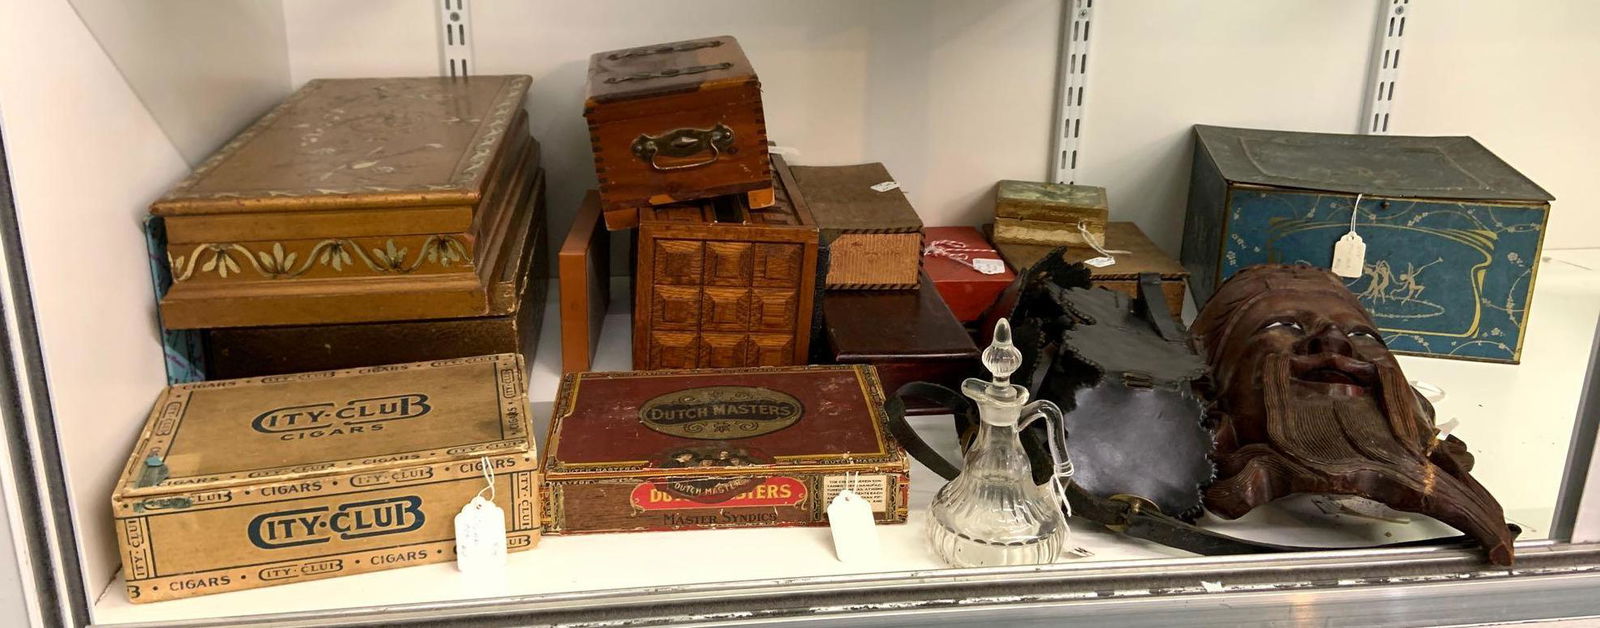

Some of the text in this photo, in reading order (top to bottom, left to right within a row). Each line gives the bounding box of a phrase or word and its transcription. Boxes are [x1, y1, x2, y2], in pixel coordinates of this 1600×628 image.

[183, 380, 236, 390] CIGARS
[358, 364, 408, 375] CIGARS
[651, 404, 791, 420] DUTCH MASTERS
[280, 423, 384, 441] CIGARS
[362, 455, 421, 465] CIGARS
[261, 481, 323, 497] CIGARS
[460, 458, 516, 473] CIGARS
[673, 481, 702, 495] DUTCH
[704, 478, 751, 496] MASTERS
[663, 513, 718, 525] MASTER
[169, 575, 231, 591] CIGARS
[370, 550, 427, 566] CIGARS
